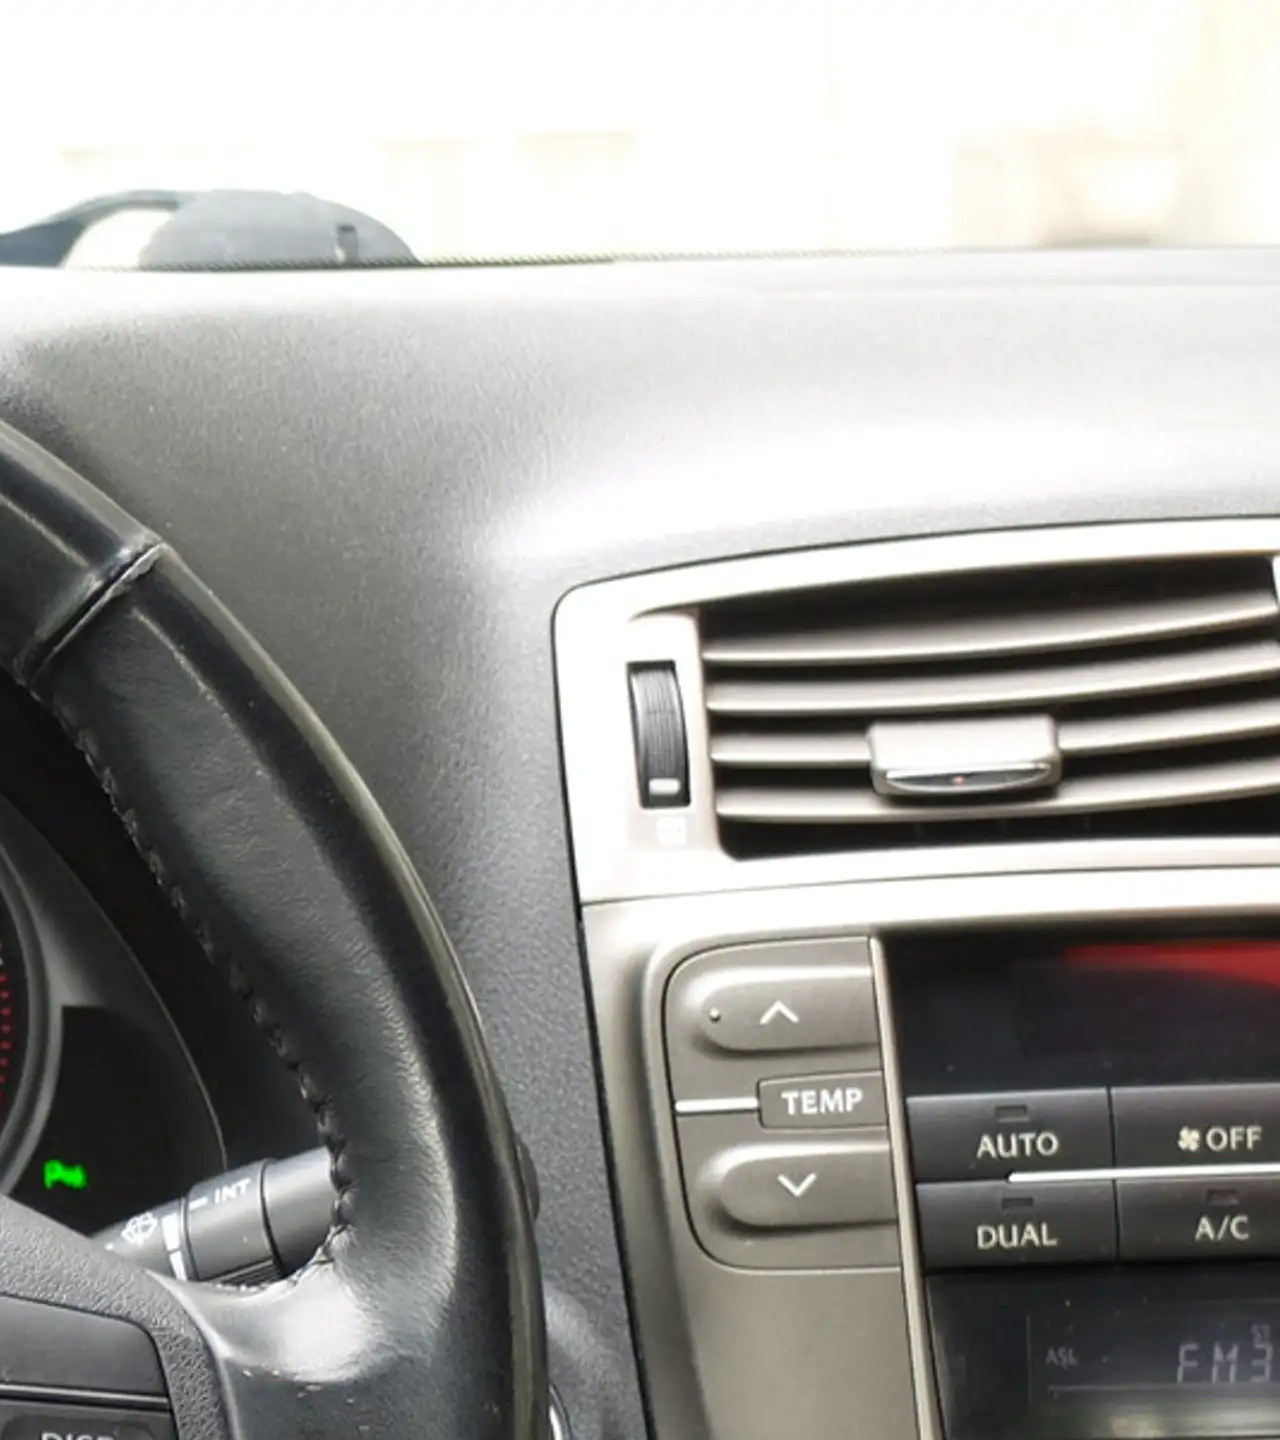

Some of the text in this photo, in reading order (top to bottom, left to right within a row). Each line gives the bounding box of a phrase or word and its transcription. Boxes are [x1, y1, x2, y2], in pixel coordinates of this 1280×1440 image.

[782, 1088, 862, 1115] TEMP
[977, 1133, 1058, 1159] AUTO
[1205, 1126, 1262, 1151] OFF
[214, 1179, 250, 1205] INT
[977, 1225, 1057, 1250] DUAL
[1195, 1217, 1249, 1241] A/C
